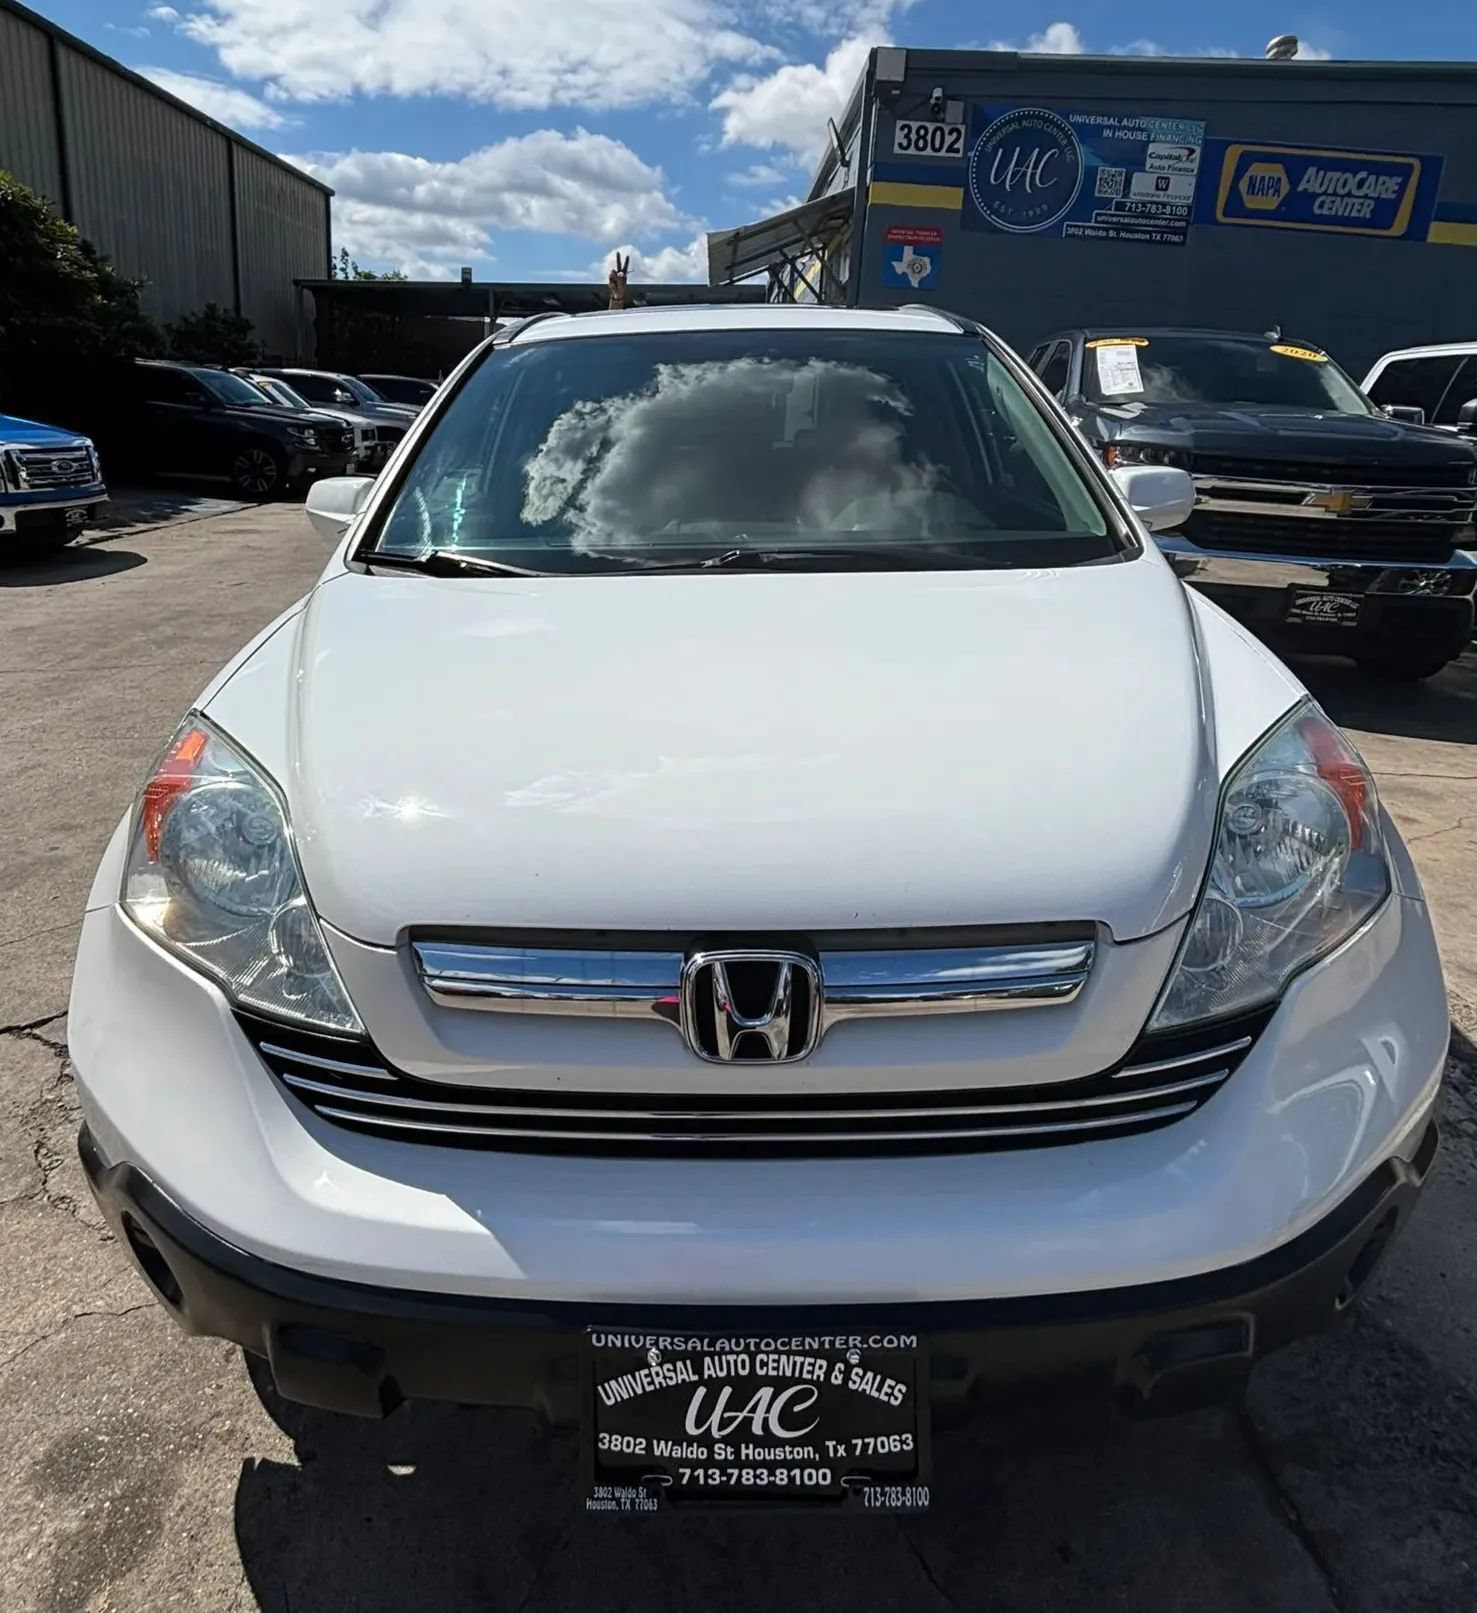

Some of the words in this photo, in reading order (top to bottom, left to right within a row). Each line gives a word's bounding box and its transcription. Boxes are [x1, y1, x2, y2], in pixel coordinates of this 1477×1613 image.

[1069, 114, 1120, 126] UNIVERSAL
[1121, 118, 1147, 129] AUTO
[1148, 120, 1185, 130] CENTER
[897, 123, 962, 154] 3802
[984, 121, 1020, 153] UNIVERSAL
[1021, 119, 1043, 129] AUTO
[1103, 129, 1112, 138] IN
[1115, 130, 1148, 141] HOUSE
[1150, 133, 1203, 144] FINANCING
[990, 146, 1060, 193] UAC
[1247, 175, 1282, 199] NAPA
[1125, 203, 1188, 216] 713-783-8100
[1313, 195, 1375, 219] CENTER
[1096, 215, 1186, 227] universalautocenter.com
[1085, 228, 1107, 236] Waldo
[1119, 231, 1150, 240] Houston
[591, 1333, 918, 1351] UNIVERSALAUTOCENTER.COM
[597, 1359, 699, 1407] UNIVERSAL
[703, 1354, 750, 1379] AUTO
[755, 1354, 828, 1382] CENTER
[831, 1364, 844, 1385] &
[847, 1367, 907, 1406] SALES
[685, 1384, 820, 1439] UAC
[597, 1432, 647, 1455] 3802
[653, 1440, 708, 1460] Waldo
[714, 1443, 734, 1460] St
[741, 1443, 819, 1461] Houston,
[825, 1440, 847, 1458] Tx
[851, 1433, 914, 1456] 77063
[678, 1468, 832, 1486] 713-783-8100
[593, 1486, 612, 1498] 3802
[614, 1486, 637, 1498] Waldo
[638, 1486, 647, 1498] St
[863, 1486, 930, 1507] 713-783-8100
[586, 1497, 619, 1510] Houston,
[620, 1498, 631, 1511] TX
[635, 1499, 658, 1511] 77063
